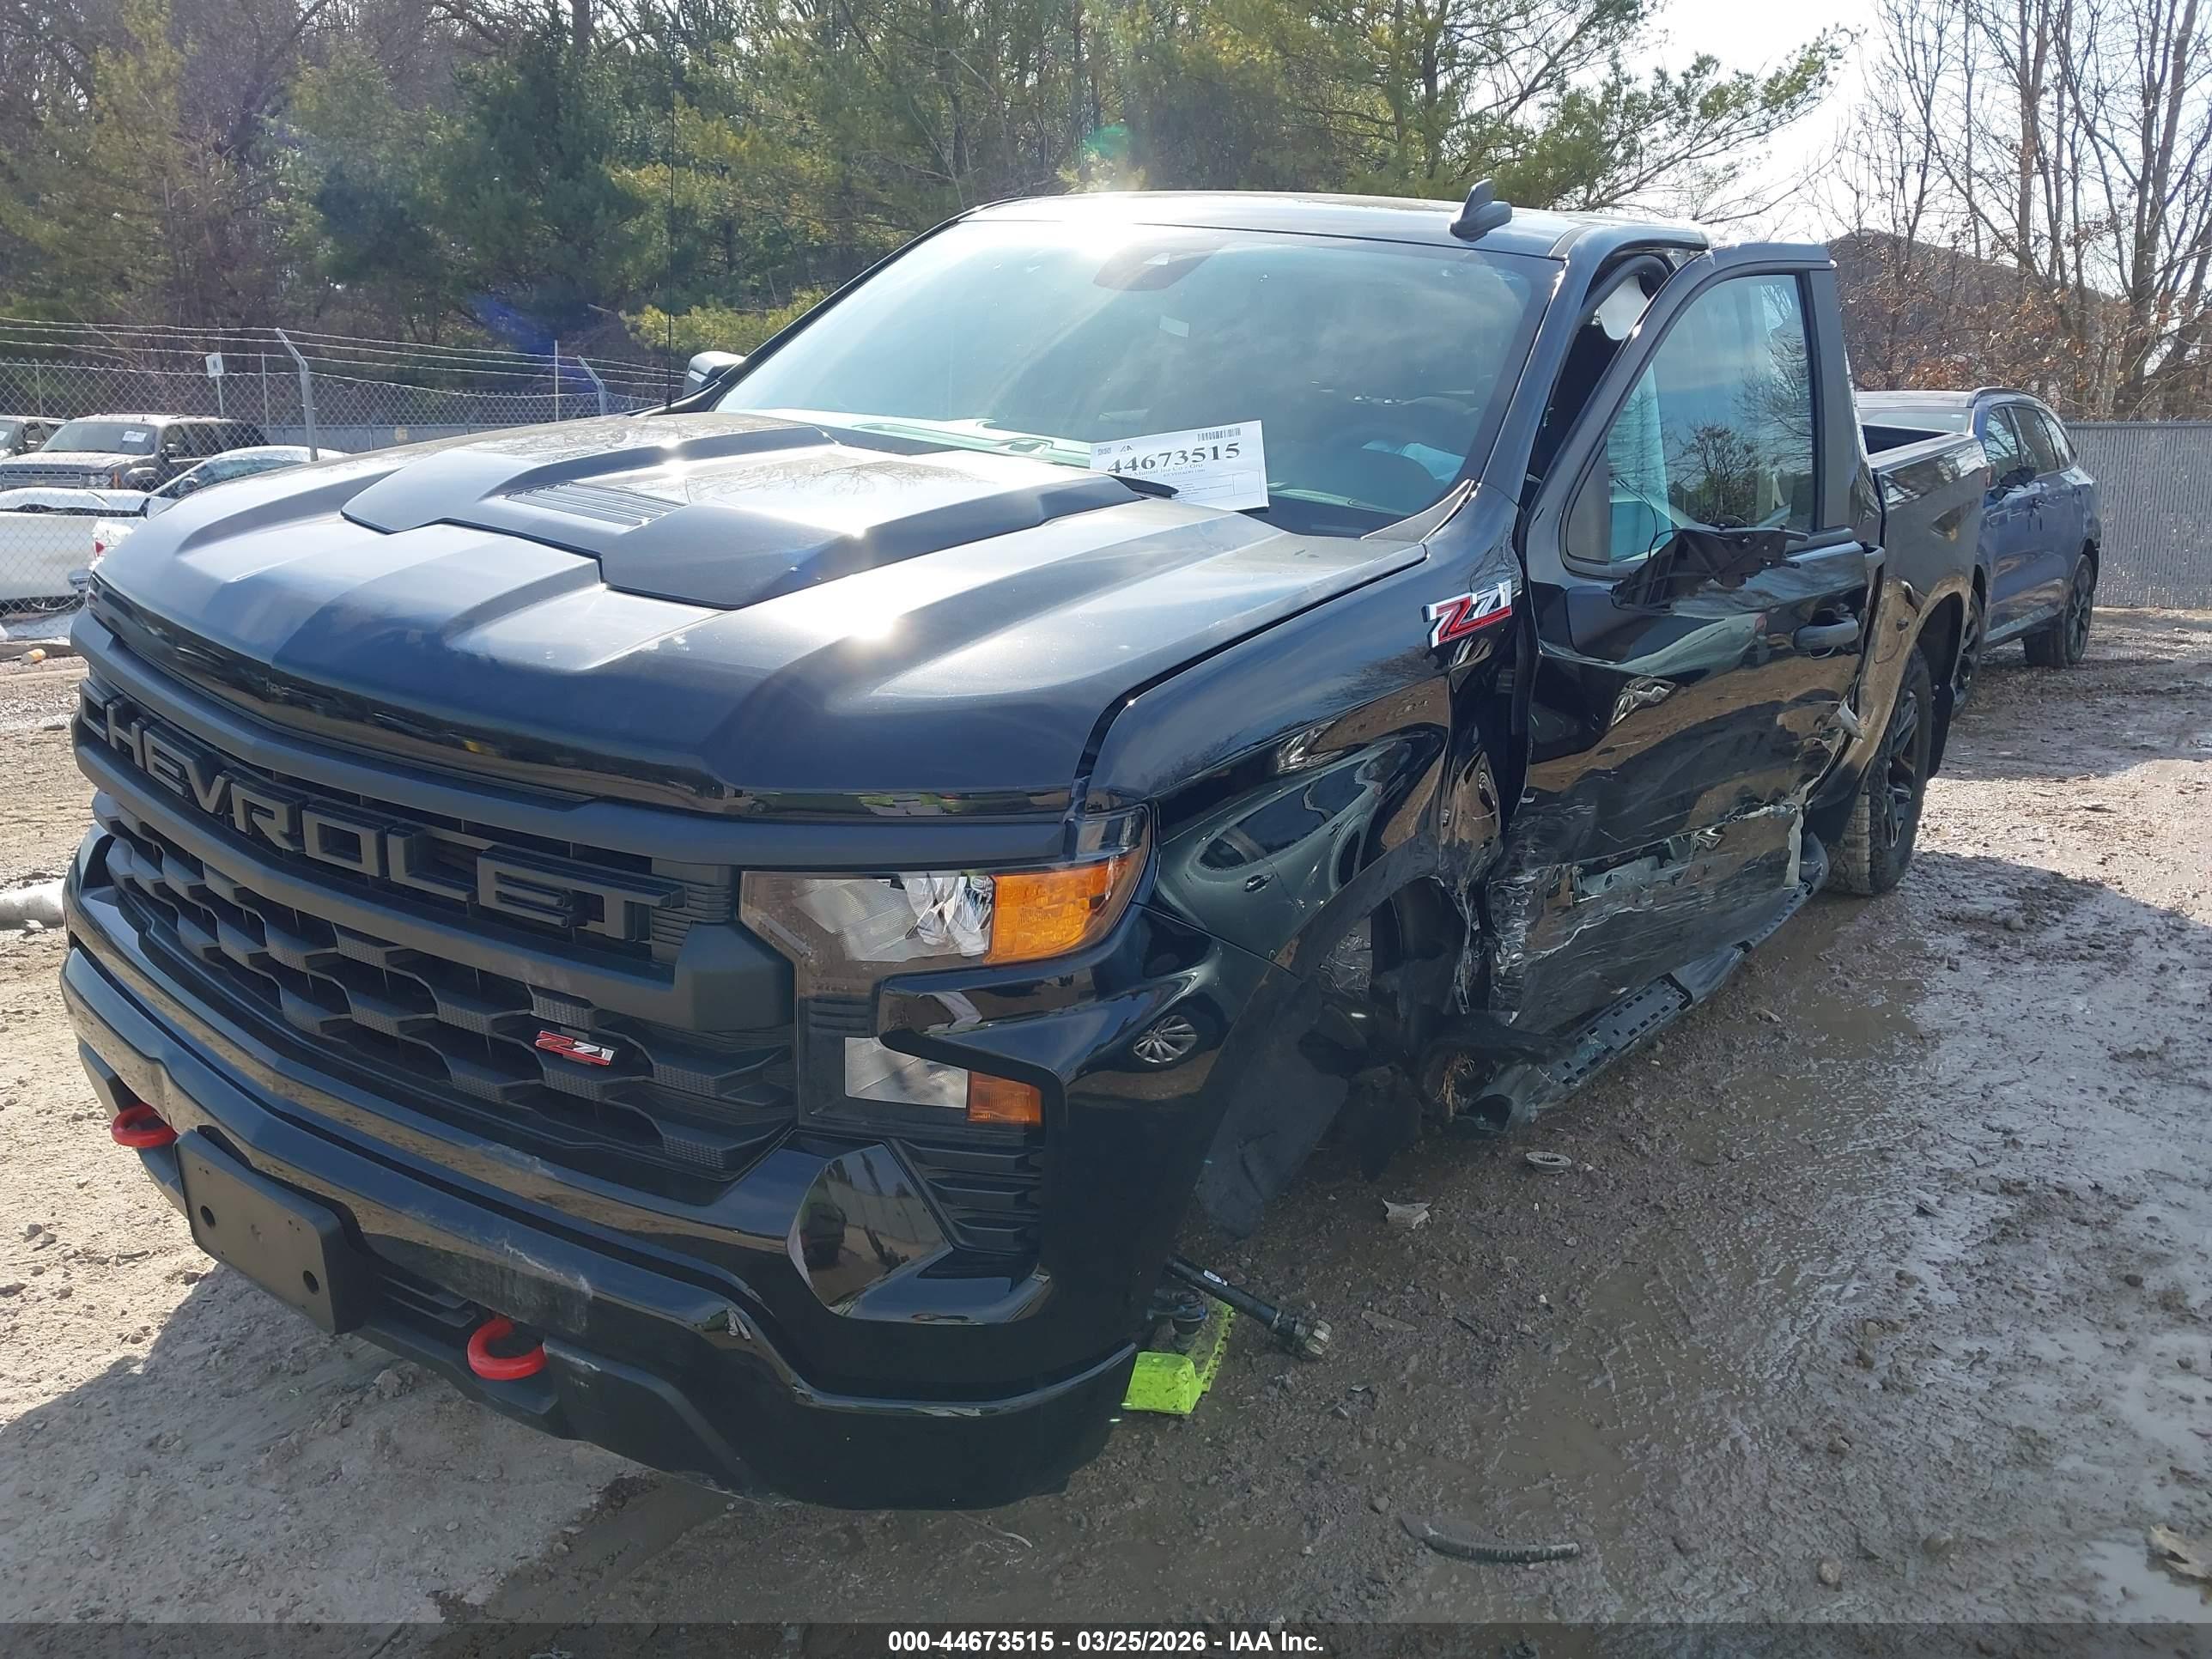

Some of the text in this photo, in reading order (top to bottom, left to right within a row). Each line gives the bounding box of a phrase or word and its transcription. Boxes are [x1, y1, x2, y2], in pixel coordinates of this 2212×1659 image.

[1106, 442, 1241, 474] 44673515
[1421, 579, 1512, 648] Z71
[80, 678, 686, 942] CHEVROLET
[535, 1030, 615, 1066] Z71
